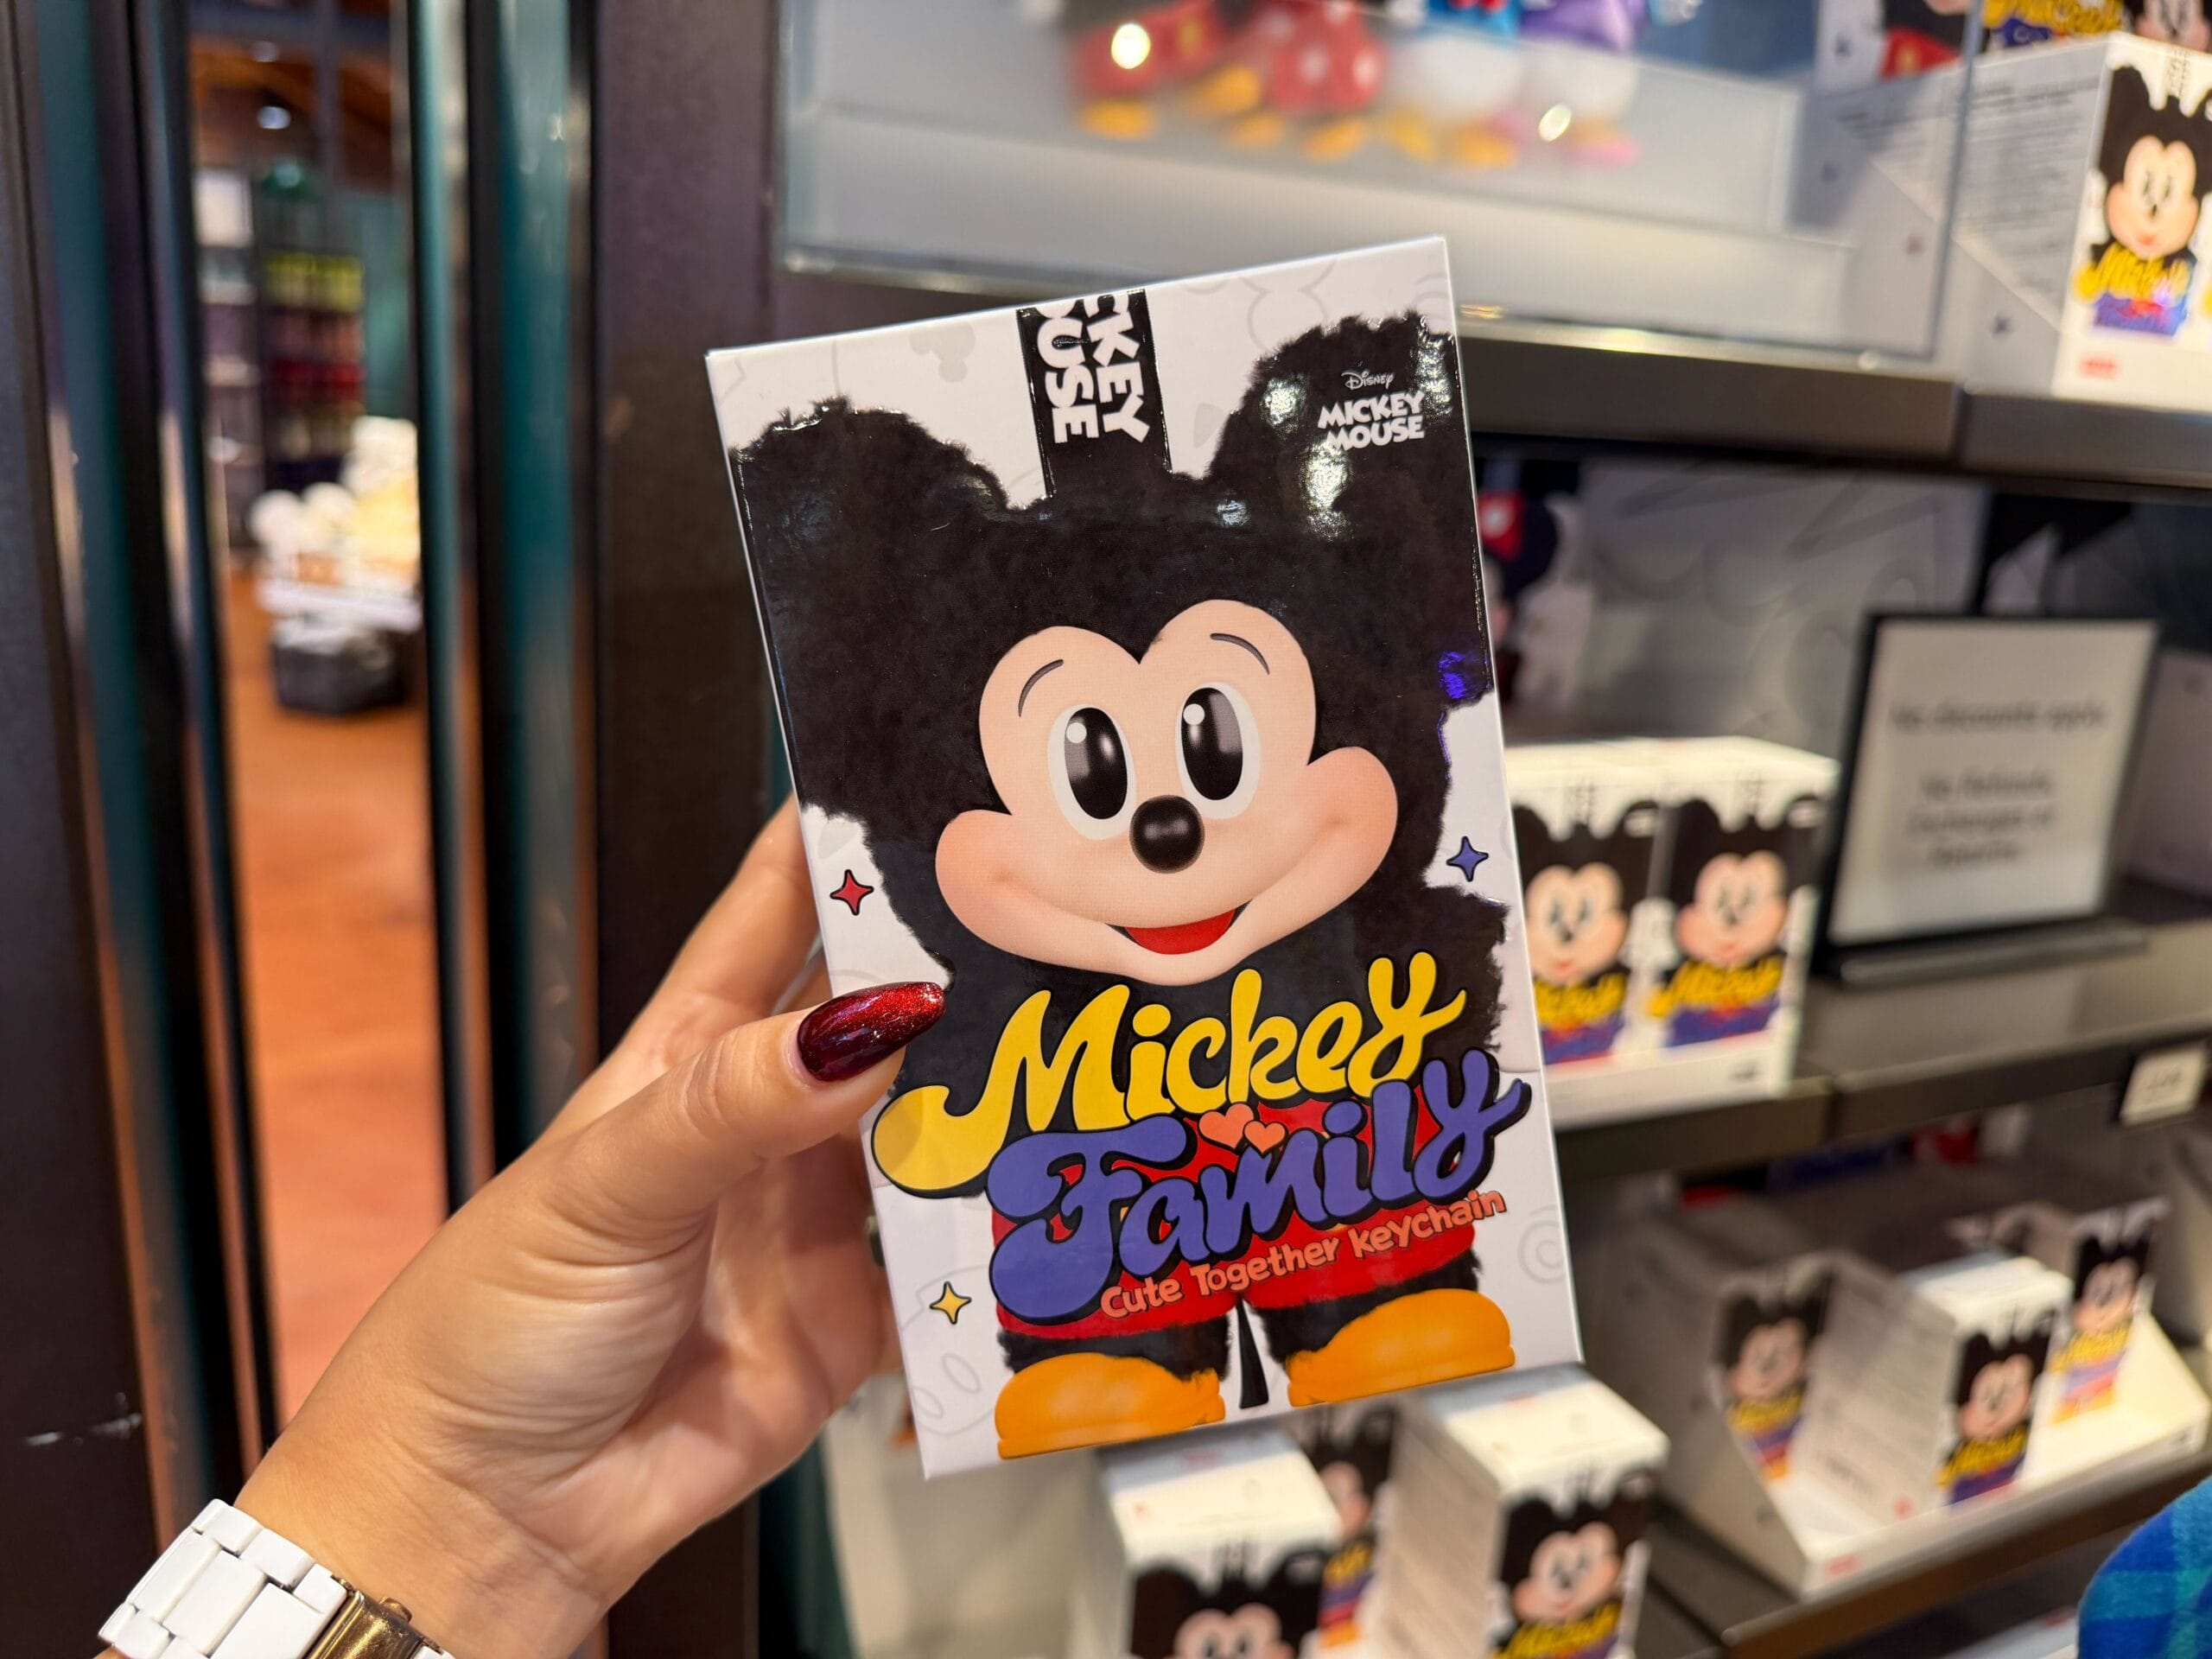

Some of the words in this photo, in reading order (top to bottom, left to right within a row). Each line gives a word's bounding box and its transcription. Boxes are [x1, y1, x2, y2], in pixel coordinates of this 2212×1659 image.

[1318, 391, 1425, 429] MICKEY
[1341, 369, 1395, 391] Disney
[1325, 415, 1425, 451] MOUSE
[872, 950, 1467, 1192] Mickey
[986, 1048, 1529, 1322] Family
[1100, 1274, 1184, 1319] Cute
[1190, 1236, 1340, 1297] Together
